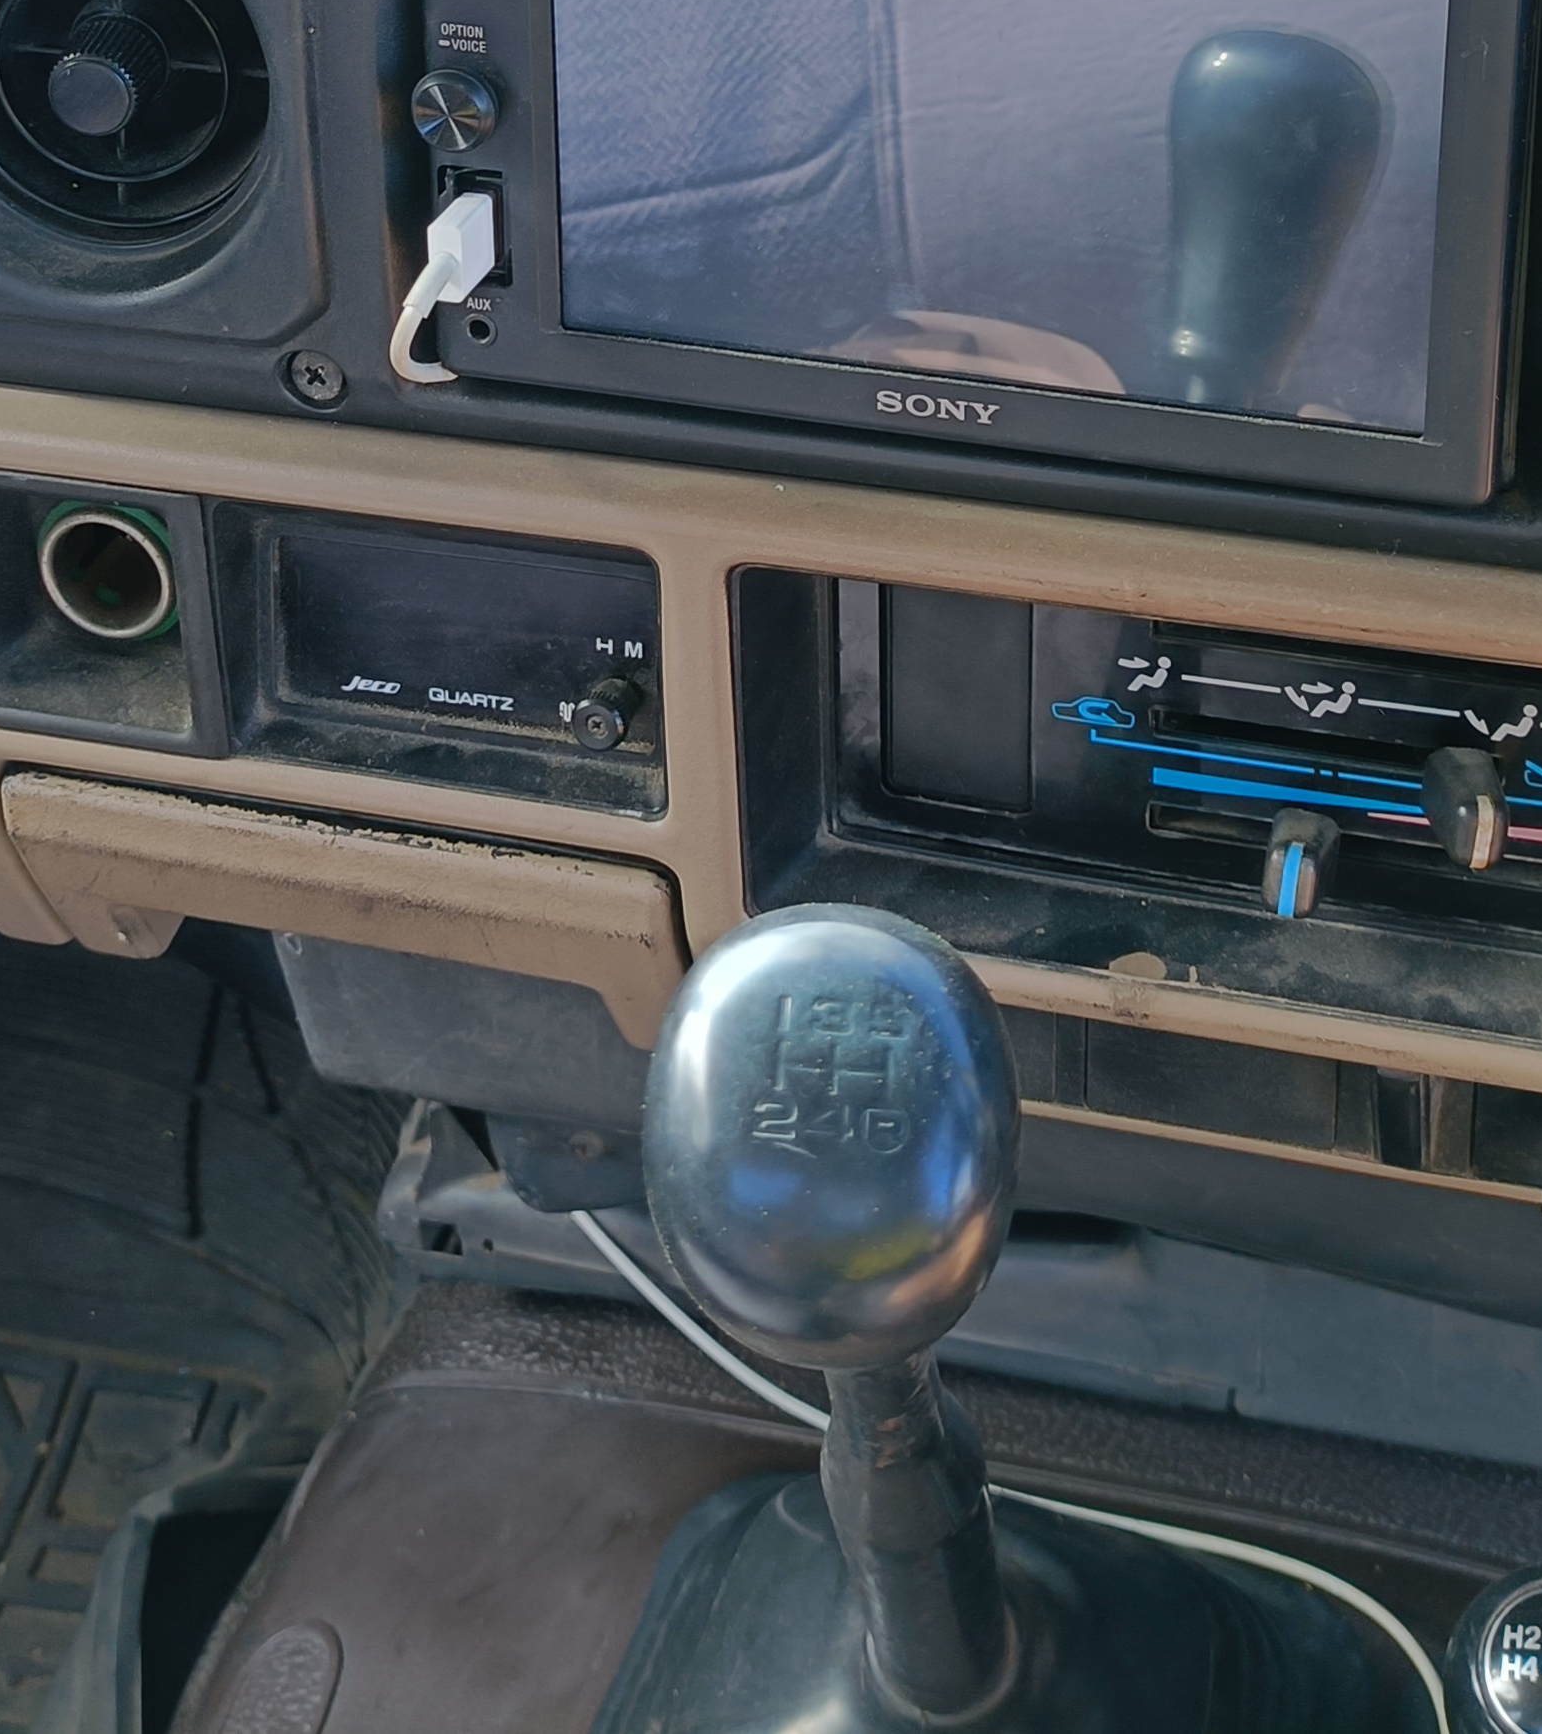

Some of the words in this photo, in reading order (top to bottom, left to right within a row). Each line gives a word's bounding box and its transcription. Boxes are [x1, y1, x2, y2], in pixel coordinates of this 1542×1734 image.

[440, 22, 484, 39] OPTION
[450, 38, 487, 54] VOICE
[466, 296, 493, 312] AUX
[876, 389, 1001, 425] SONY
[595, 637, 614, 656] H
[624, 640, 644, 660] M
[428, 687, 515, 713] QUARTZ
[752, 1102, 799, 1140] 2
[1503, 1624, 1542, 1650] H2
[1500, 1654, 1539, 1683] H4
